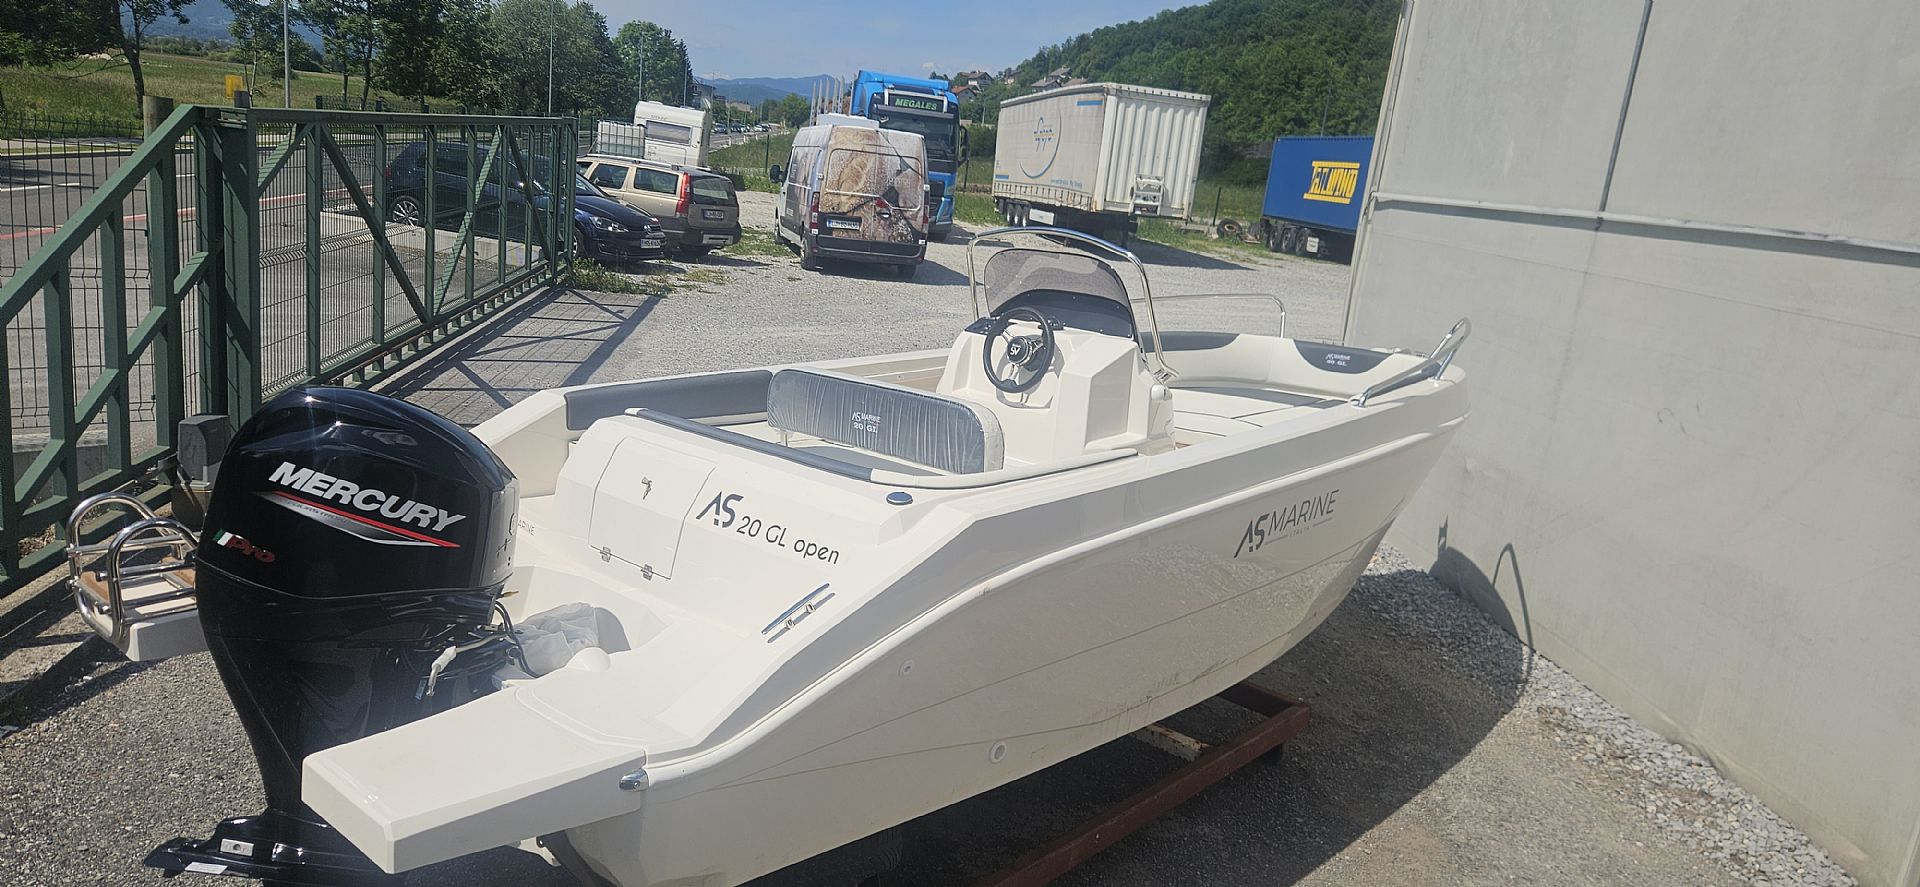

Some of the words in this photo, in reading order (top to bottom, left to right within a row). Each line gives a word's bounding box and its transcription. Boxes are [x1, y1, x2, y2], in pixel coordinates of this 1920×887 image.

[895, 98, 938, 111] MEGALES
[854, 422, 863, 430] 20
[268, 461, 467, 532] MERCURY
[696, 491, 744, 529] AS
[736, 515, 762, 538] 20
[765, 524, 788, 548] GL
[793, 539, 840, 565] open
[1233, 513, 1270, 558] AS
[1268, 489, 1339, 536] MARINE
